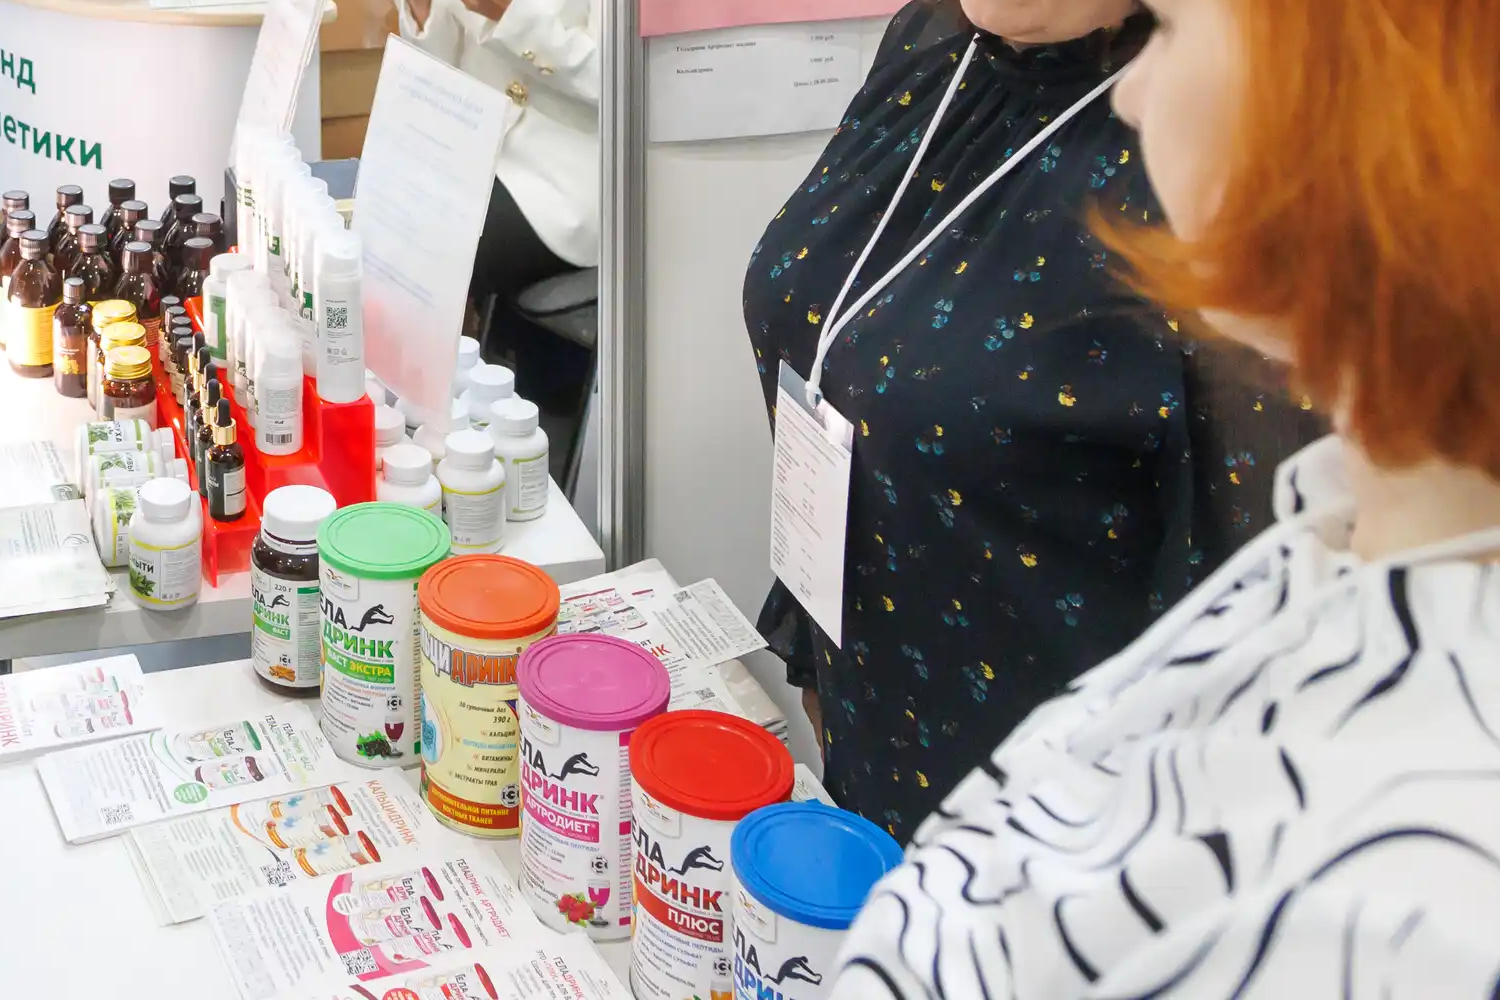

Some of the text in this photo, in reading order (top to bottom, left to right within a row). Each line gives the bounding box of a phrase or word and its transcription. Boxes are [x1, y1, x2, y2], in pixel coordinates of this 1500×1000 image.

[274, 583, 287, 593] 220
[253, 600, 290, 626] ДРИНК
[322, 620, 394, 659] ДРИНК
[349, 659, 392, 677] ЭКСТРА
[493, 716, 505, 724] 390
[489, 730, 516, 738] КАЛЬЦИЙ
[481, 754, 513, 762] ВИТАМИНЫ
[454, 772, 484, 786] ЭКСТРАКТЫ
[473, 766, 507, 775] МИНЕРАЛЫ
[522, 759, 600, 815] ДРИНК
[365, 779, 417, 846] КАЛЬЦИДРИНК
[468, 813, 493, 825] ТКАНЕЙ
[480, 806, 509, 816] ПИТАНИЕ
[525, 797, 592, 834] АРТРОДИЕТ
[635, 850, 723, 912] ДРИНК
[480, 896, 511, 940] АРТРОДИЕТ
[667, 906, 720, 935] ПЛЮС
